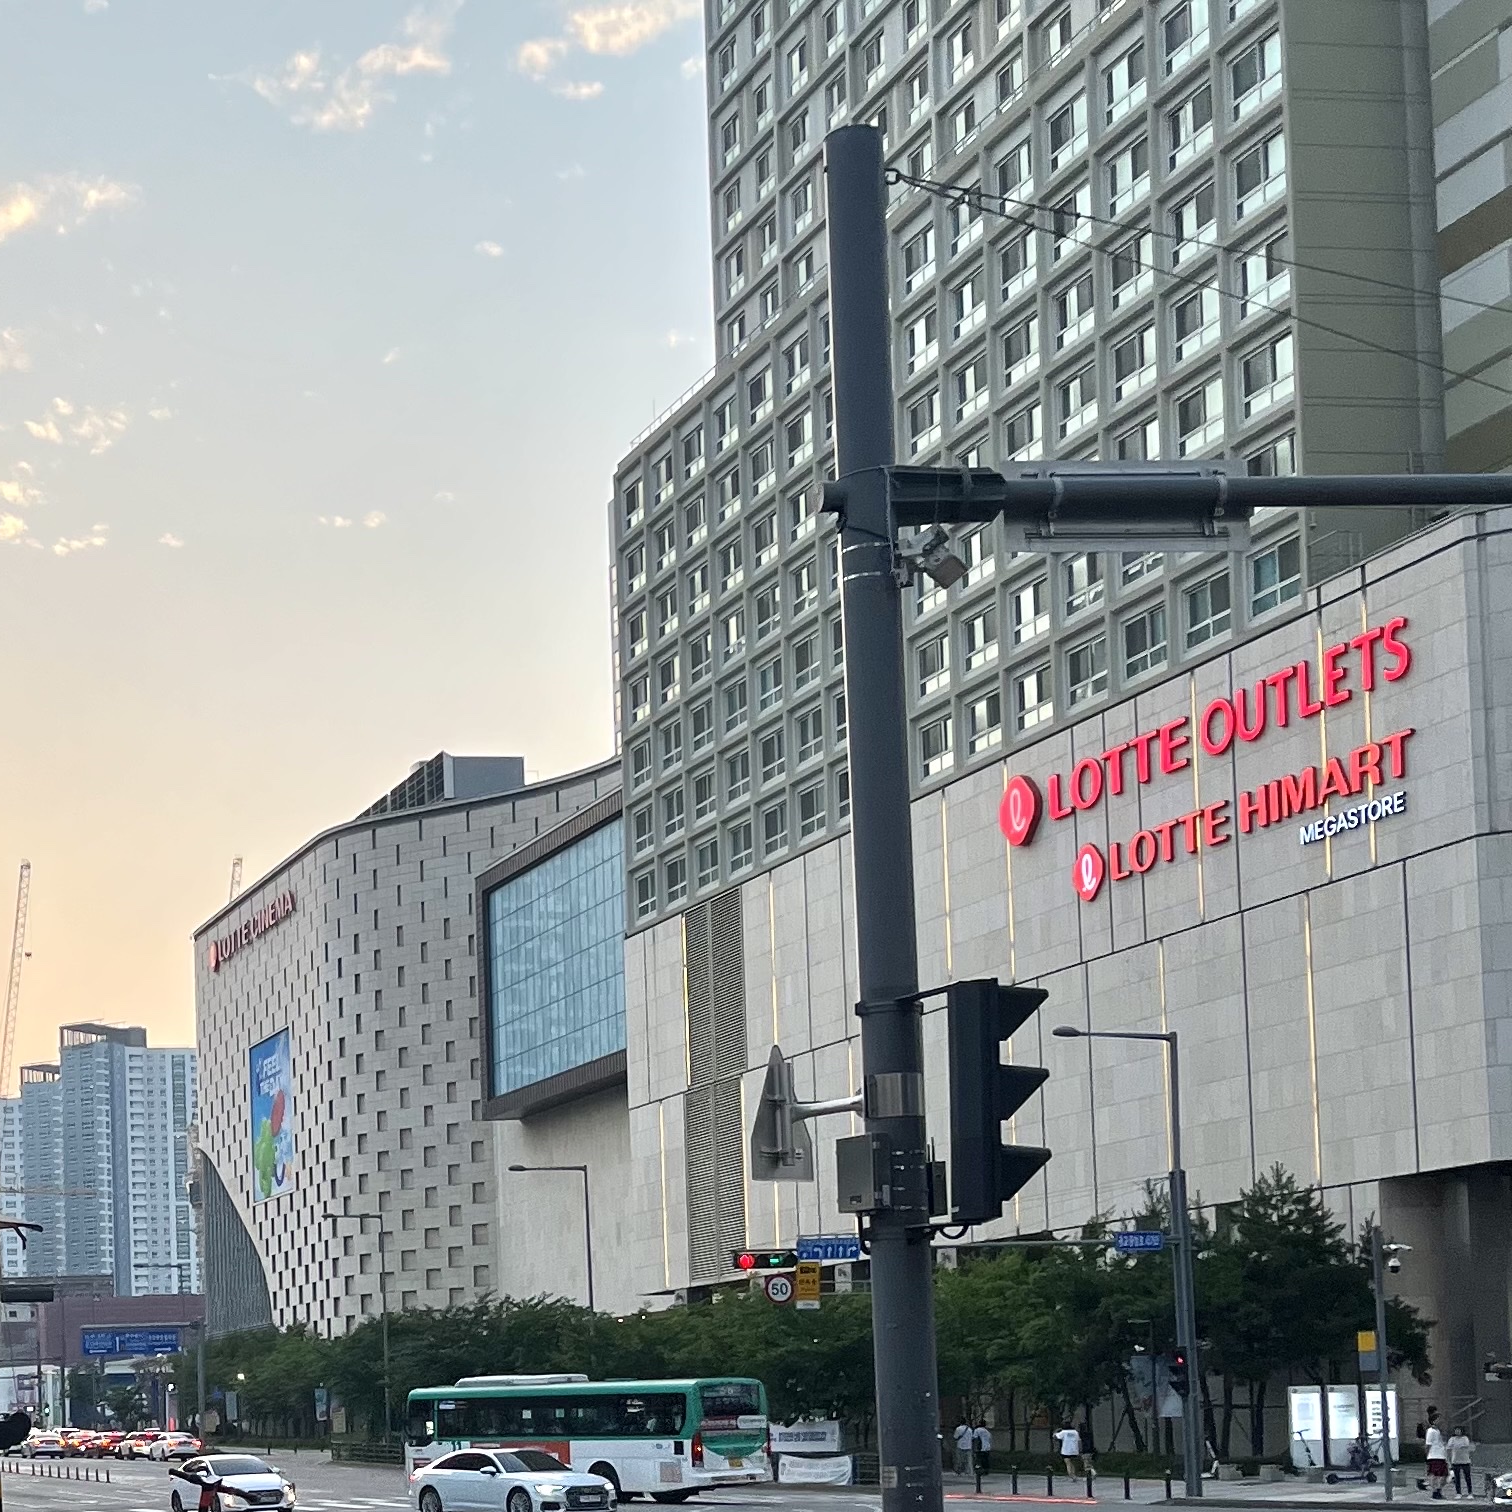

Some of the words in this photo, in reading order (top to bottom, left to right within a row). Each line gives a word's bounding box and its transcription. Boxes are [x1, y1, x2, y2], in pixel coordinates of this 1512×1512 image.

[1047, 716, 1190, 822] LOTTE
[1199, 616, 1412, 756] OUTLETS
[1109, 799, 1230, 882] LOTTE
[1239, 727, 1416, 834] HIMART
[1299, 791, 1406, 845] MEGASTORE
[217, 920, 249, 962] LOTTE
[250, 890, 295, 939] CINEMA
[771, 1282, 788, 1296] 50
